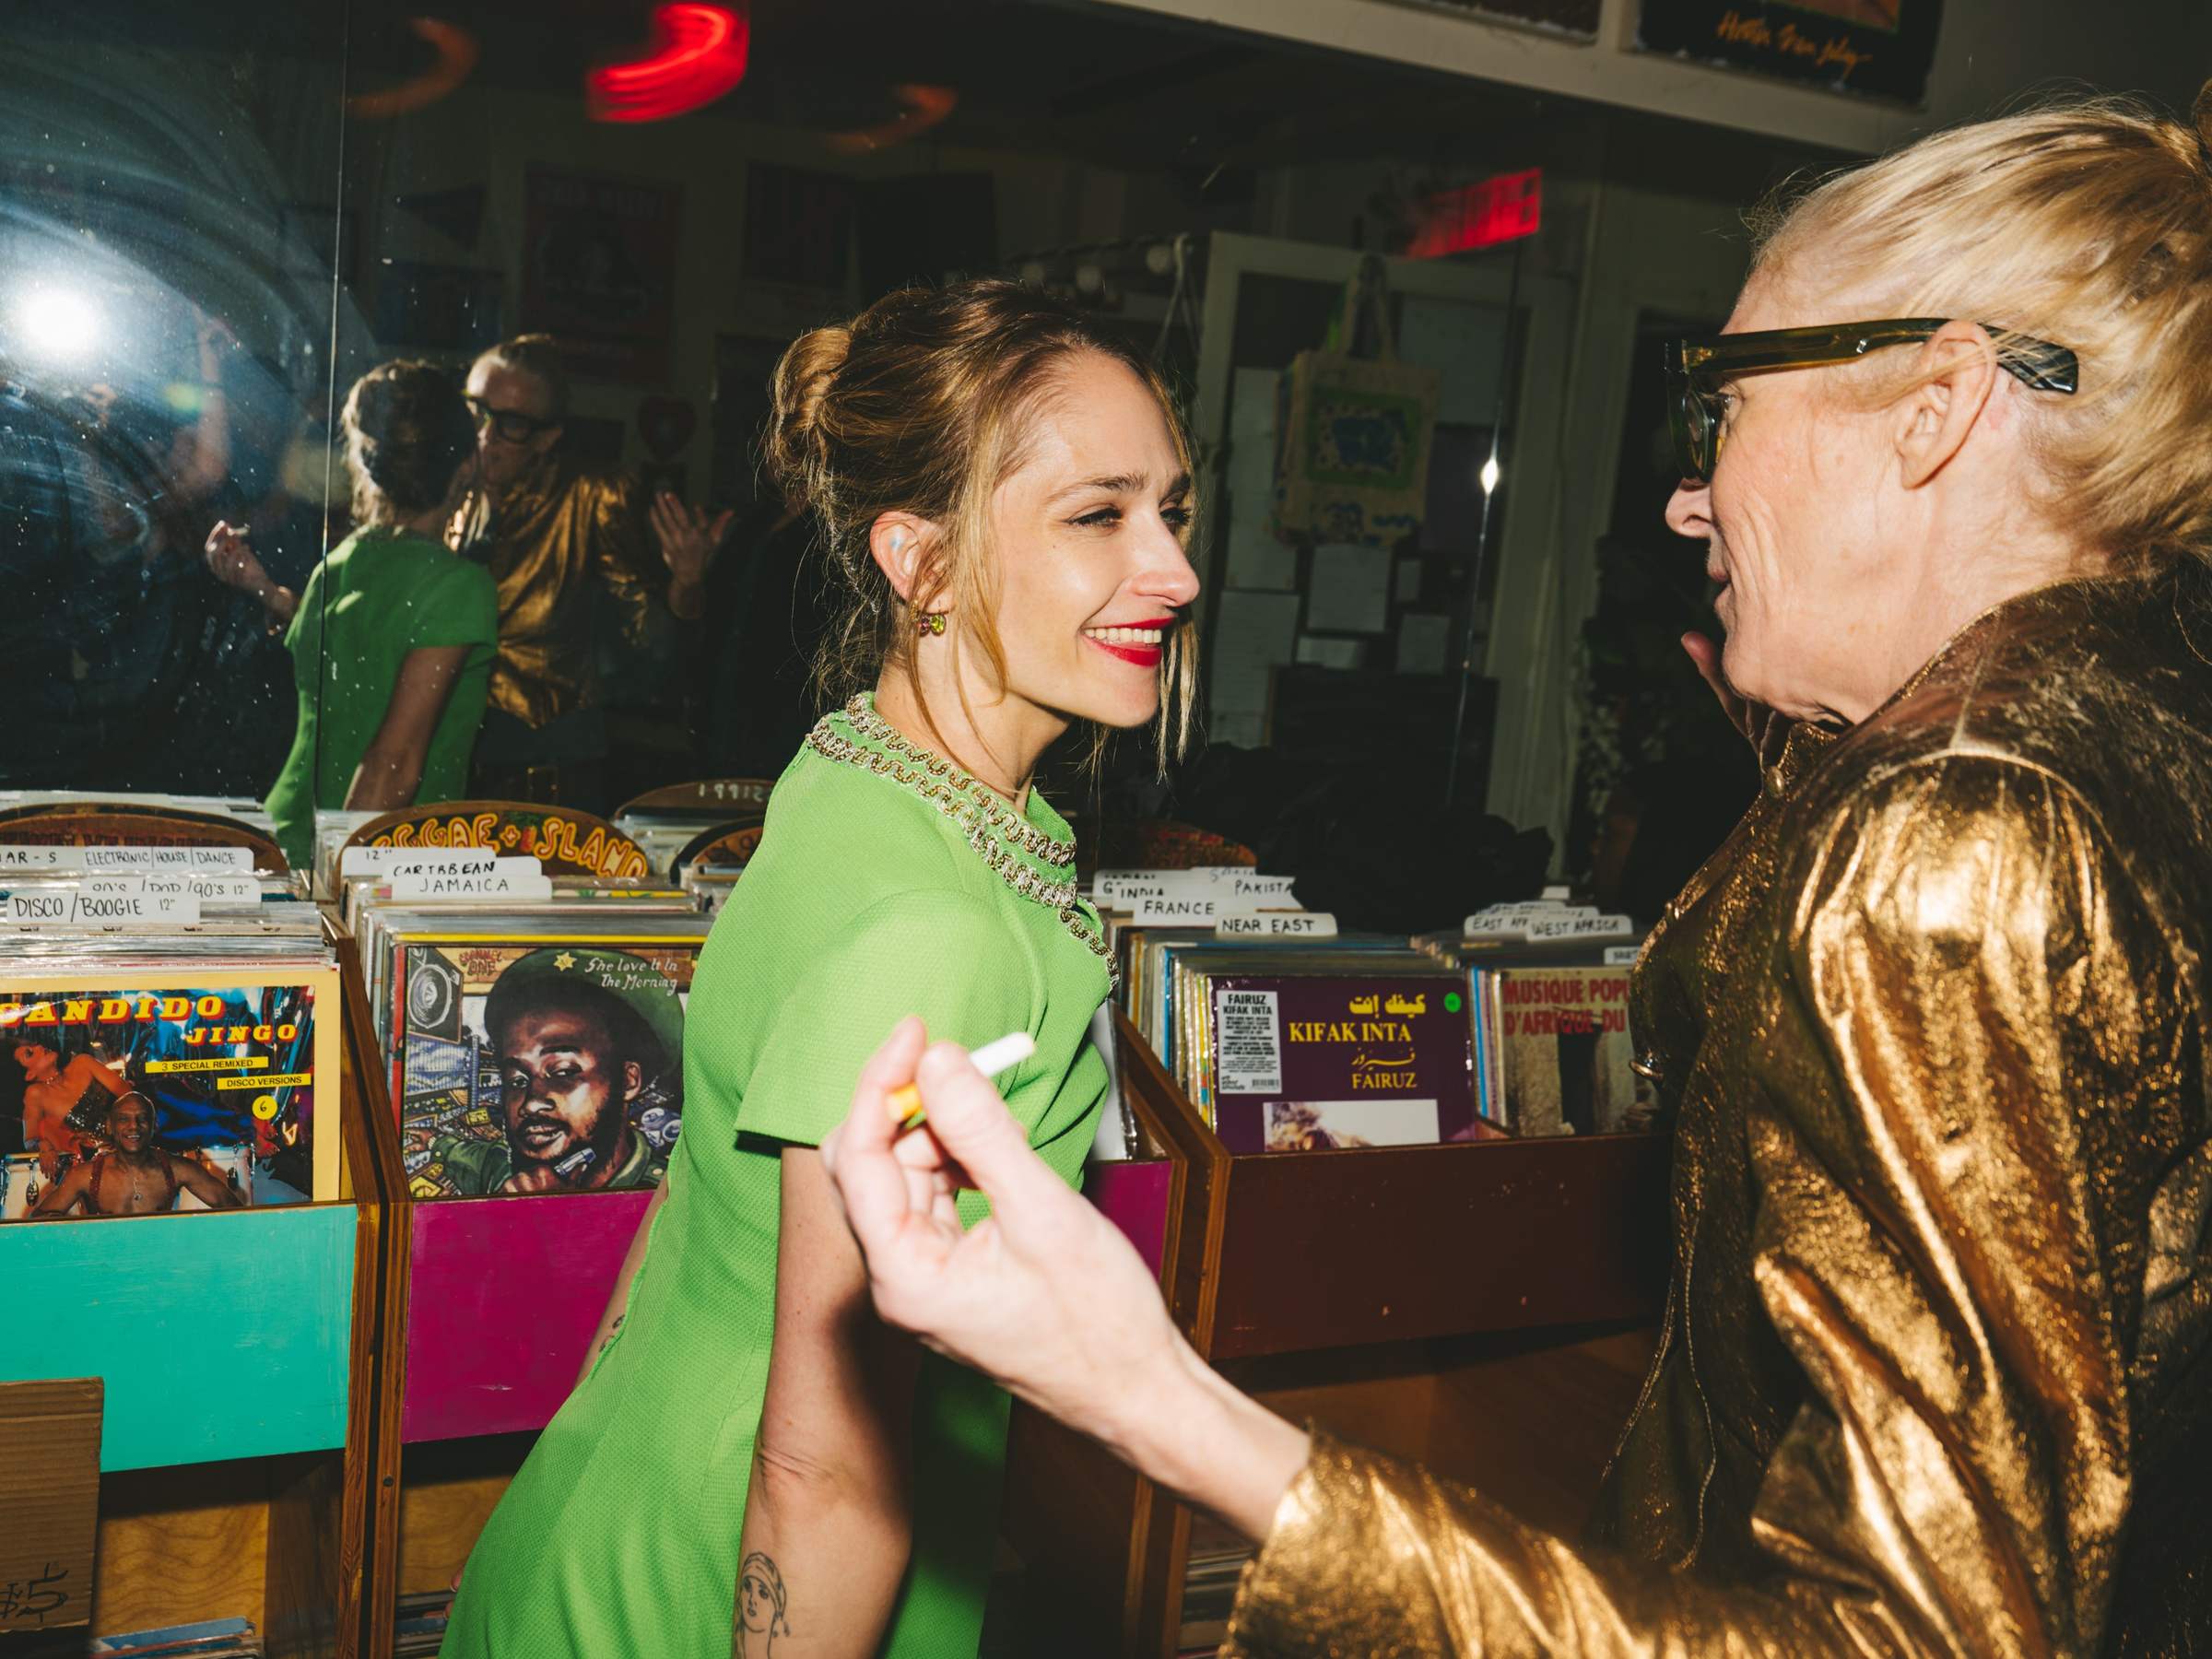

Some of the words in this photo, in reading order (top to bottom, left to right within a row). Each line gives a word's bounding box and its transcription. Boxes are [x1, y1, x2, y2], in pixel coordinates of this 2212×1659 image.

[371, 813, 500, 853] GGAE
[0, 852, 28, 864] AR
[420, 877, 509, 892] JAMAICA
[1235, 878, 1292, 896] PAKISTA
[1144, 900, 1215, 915] FRANCE
[1222, 920, 1262, 933] NEAR
[1272, 919, 1315, 933] EAST
[584, 957, 614, 973] She
[601, 973, 621, 988] The
[621, 973, 678, 996] Morning
[1503, 978, 1584, 1005] MUSIQUE
[1228, 994, 1266, 1005] FAIRUZ
[1252, 1006, 1272, 1015] INTA
[1503, 1009, 1594, 1036] D'AFRIQUE
[1602, 1009, 1625, 1032] DU
[184, 1024, 300, 1047] JINGO
[1288, 1022, 1358, 1042] KIFAK
[1360, 1022, 1413, 1042] INTA
[161, 1063, 169, 1072] 3
[172, 1061, 210, 1071] SPECIAL
[213, 1059, 253, 1069] REMIXED
[227, 1078, 255, 1088] DISCO
[258, 1076, 302, 1086] VERSIONS
[1351, 1072, 1418, 1089] FAIRUZ
[259, 1100, 267, 1112] 6
